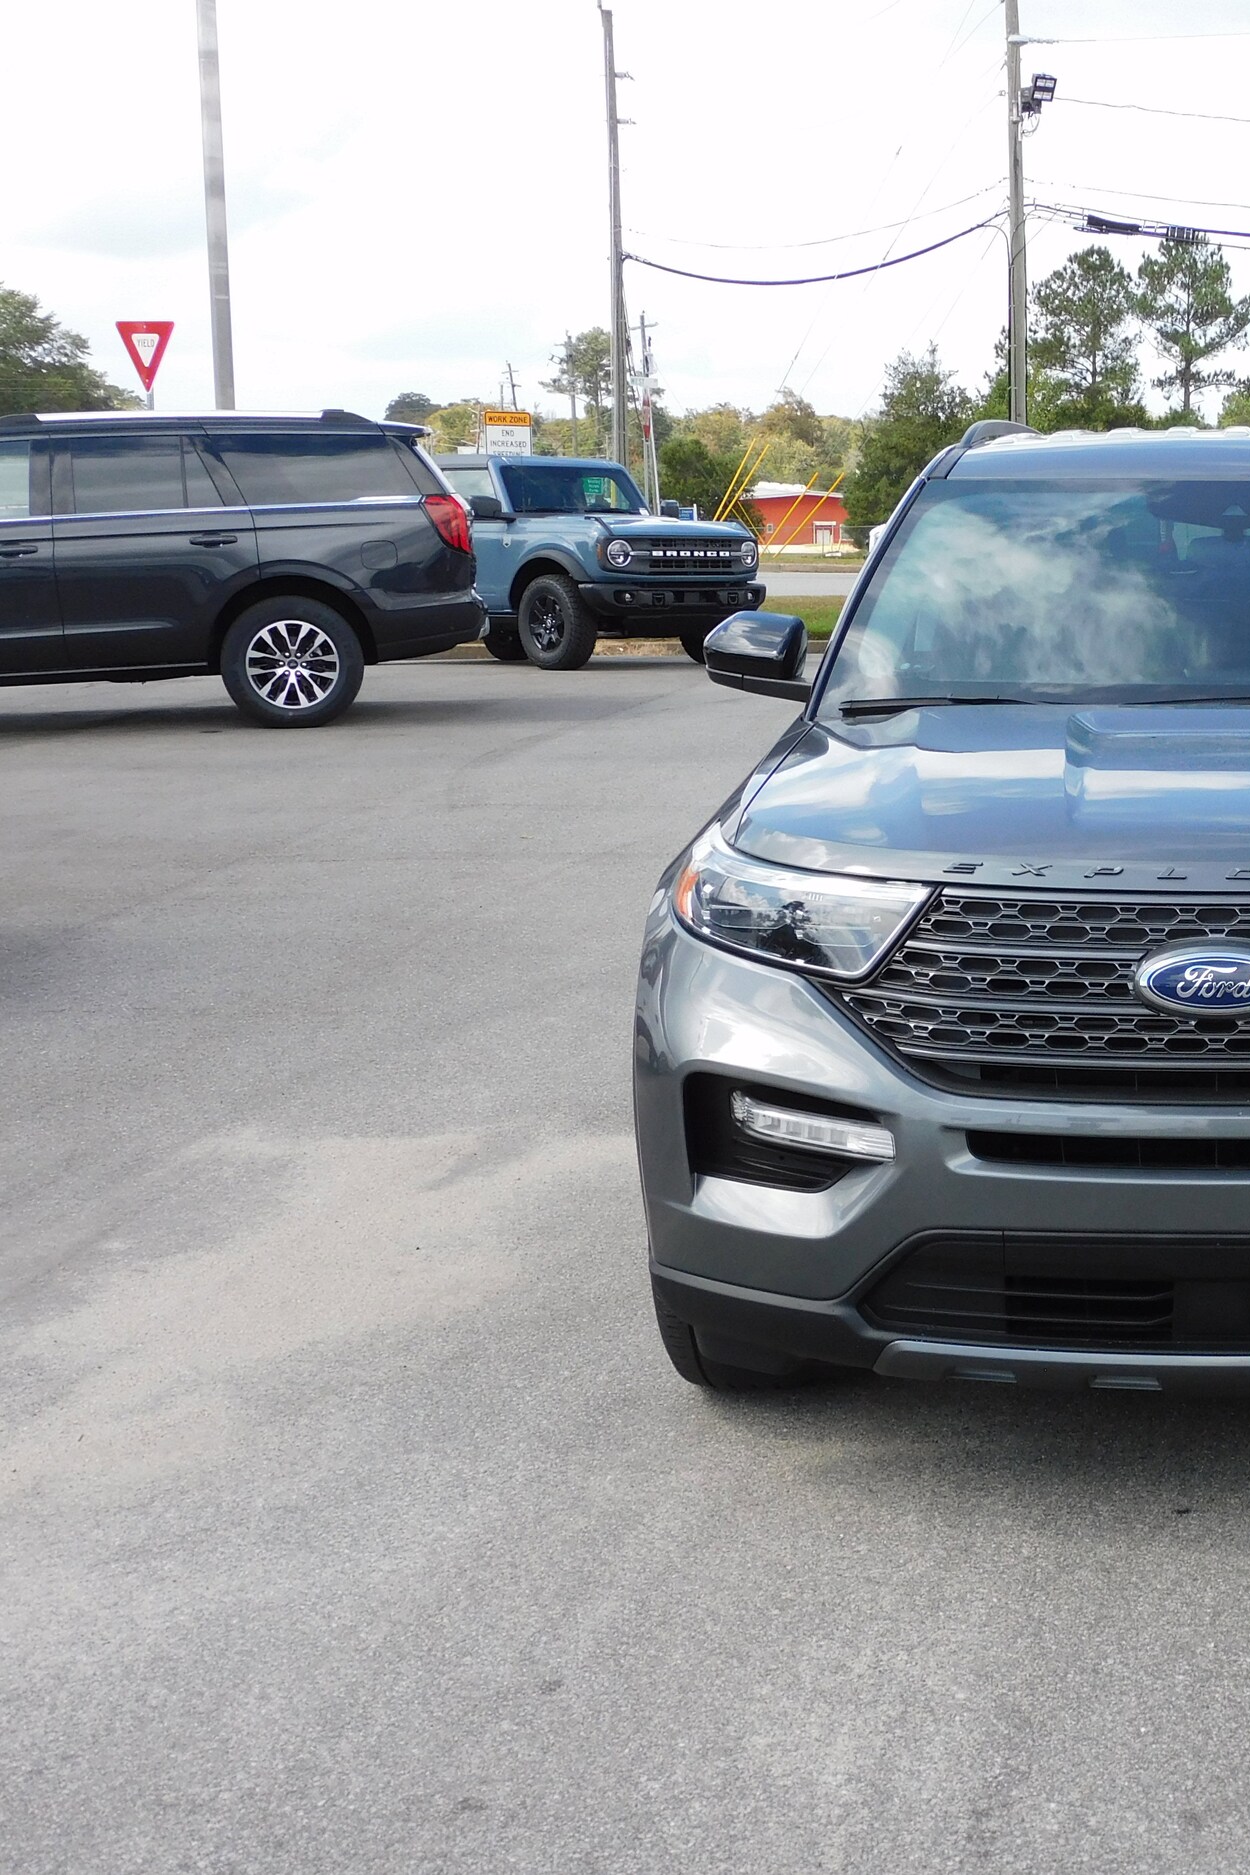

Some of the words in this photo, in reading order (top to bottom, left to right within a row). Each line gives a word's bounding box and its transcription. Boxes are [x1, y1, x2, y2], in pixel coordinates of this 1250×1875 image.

[137, 339, 155, 348] YIELD
[488, 415, 508, 423] WORK
[510, 416, 528, 424] ZONE
[501, 429, 515, 437] END
[490, 440, 527, 448] INCREASED
